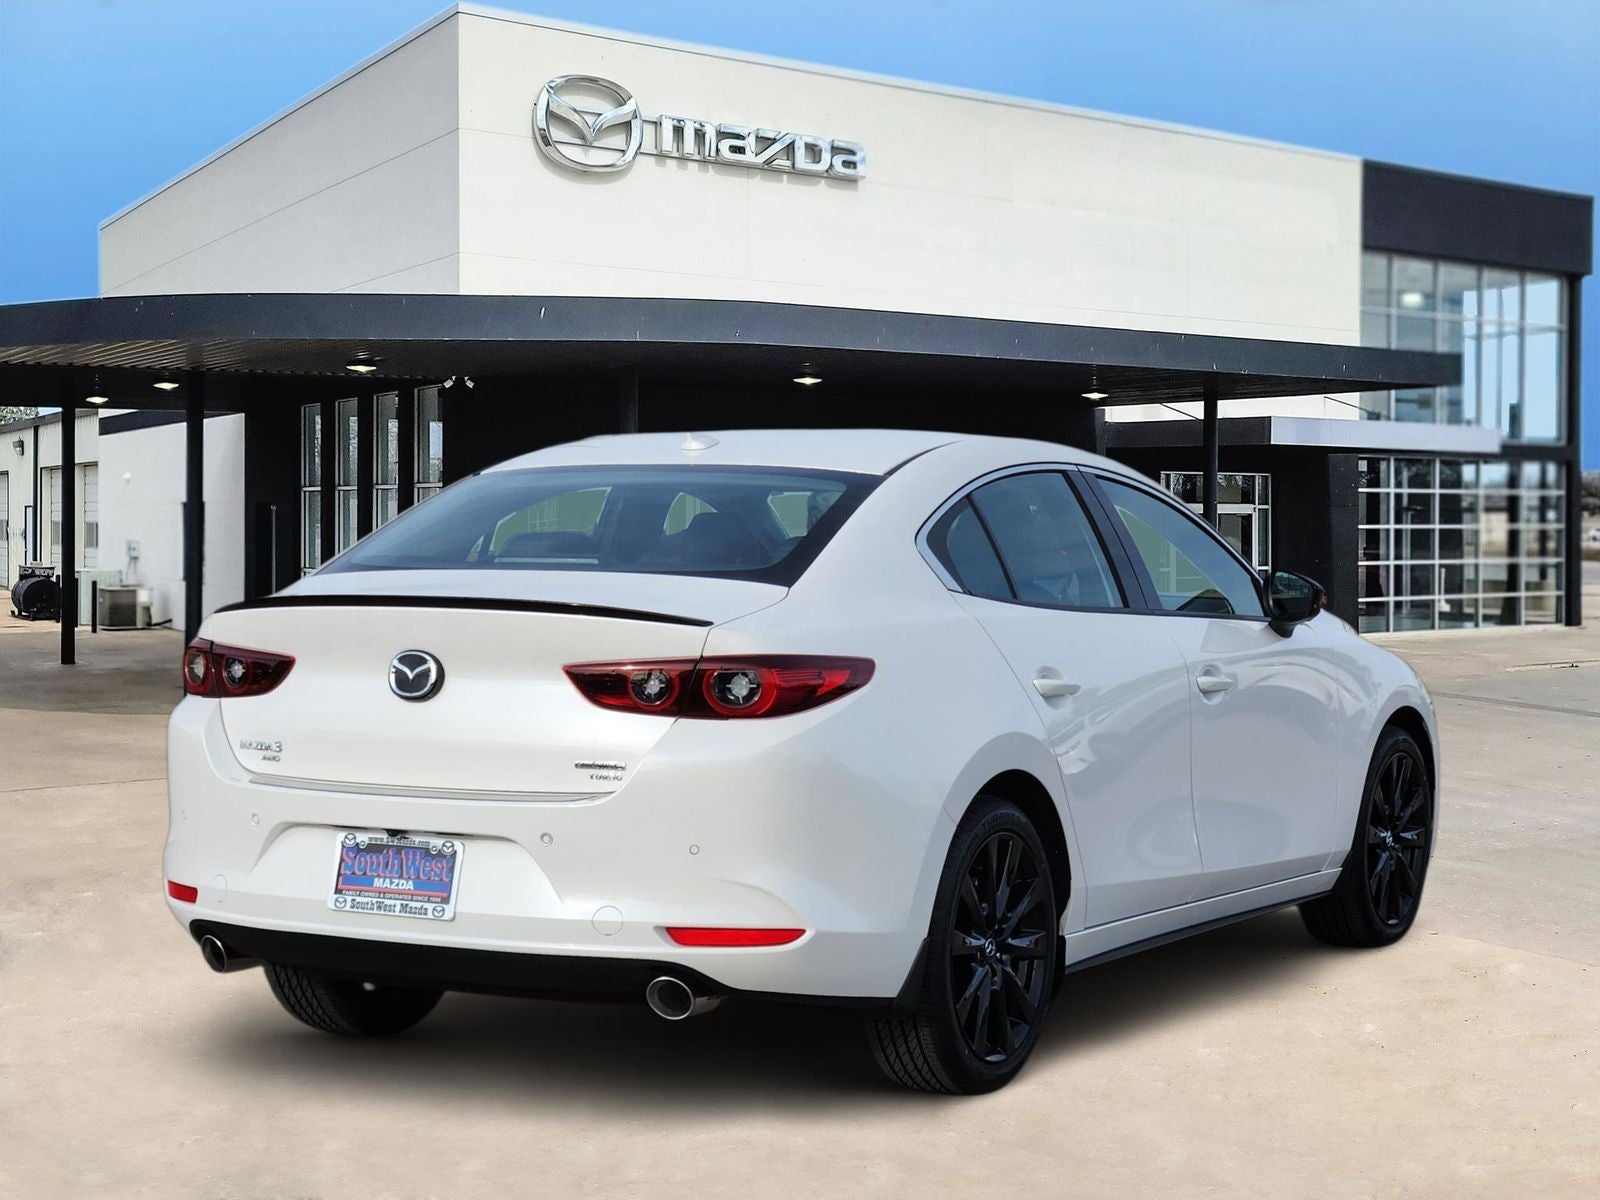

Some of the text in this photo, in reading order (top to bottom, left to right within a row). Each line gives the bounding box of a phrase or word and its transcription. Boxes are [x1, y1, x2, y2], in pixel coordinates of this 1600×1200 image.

[373, 877, 415, 891] MAZDA
[342, 889, 360, 897] FAMILY
[360, 890, 380, 898] OWNED
[385, 893, 412, 901] OPERATED
[399, 902, 429, 916] Mazda
